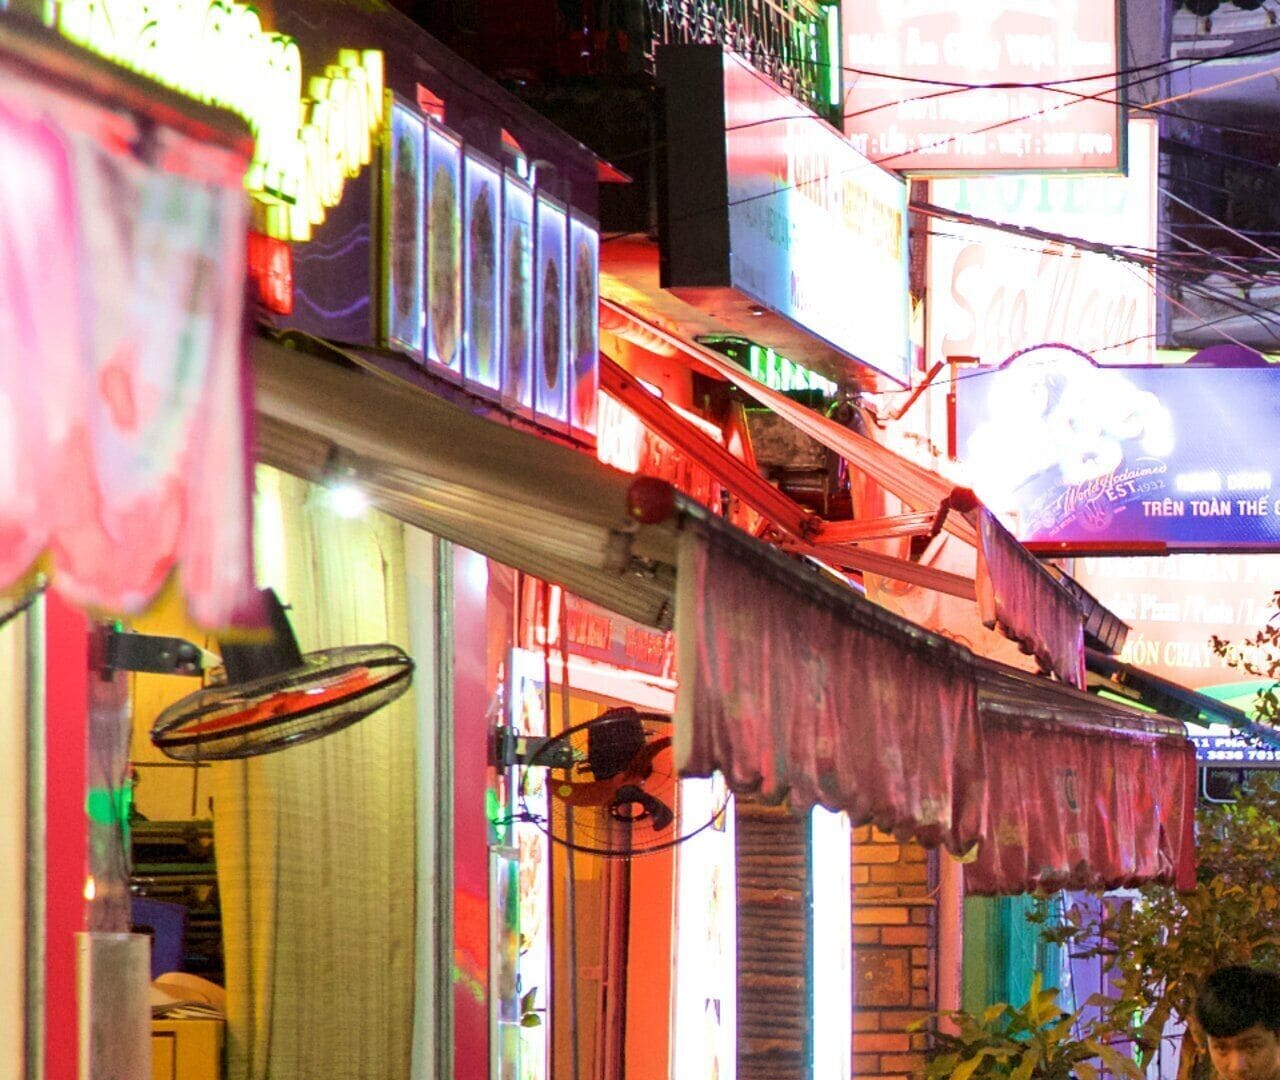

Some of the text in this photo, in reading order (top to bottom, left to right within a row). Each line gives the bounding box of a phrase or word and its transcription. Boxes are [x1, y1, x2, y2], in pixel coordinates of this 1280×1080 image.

[1143, 497, 1184, 516] TRÊN
[1190, 496, 1231, 516] TOÀN
[1237, 494, 1270, 516] THẾ
